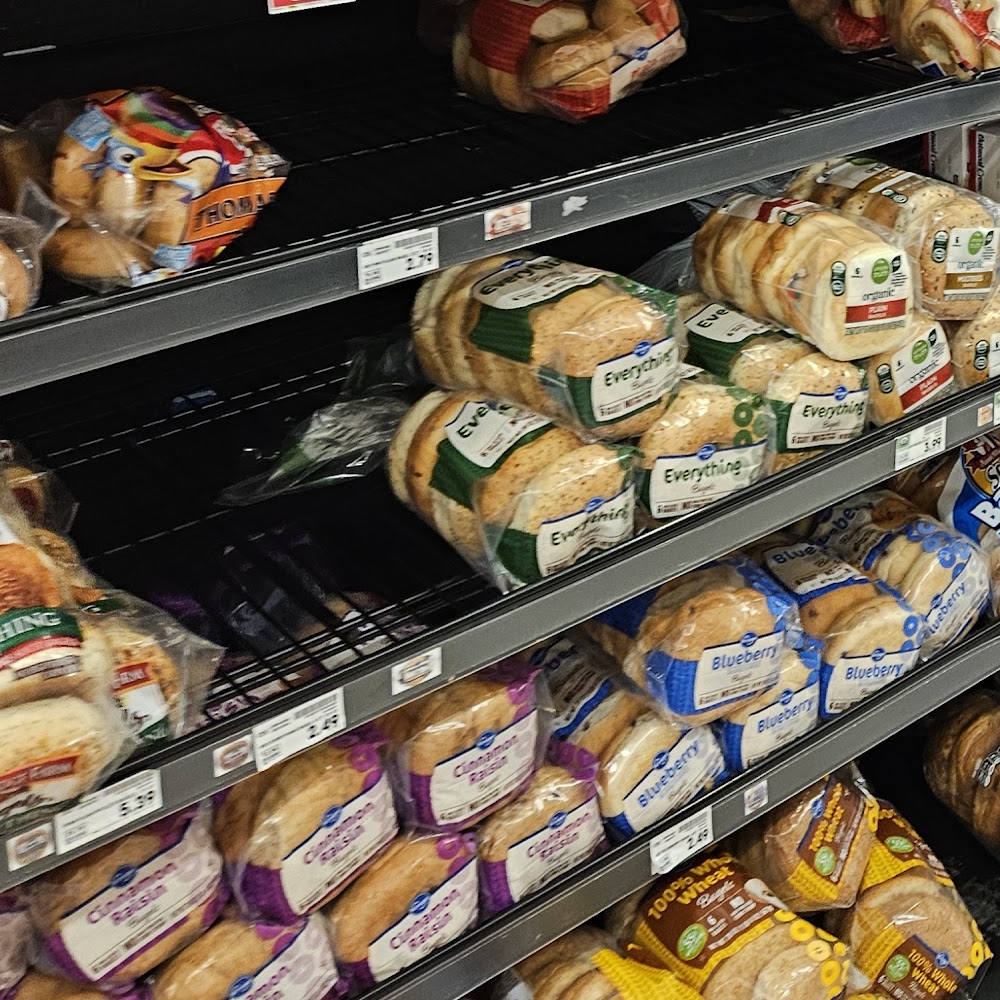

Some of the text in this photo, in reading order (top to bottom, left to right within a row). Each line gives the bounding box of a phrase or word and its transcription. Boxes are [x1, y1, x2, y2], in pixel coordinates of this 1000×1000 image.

[862, 288, 895, 301] organic
[604, 350, 674, 388] Everything
[909, 360, 940, 384] organic
[802, 399, 865, 419] Everything
[663, 455, 743, 486] Everything
[711, 642, 780, 671] Blueberry
[845, 656, 904, 681] Blueberry
[757, 696, 815, 735] Blueberry
[453, 734, 520, 779] Cinnamon
[469, 754, 508, 785] Raisin
[638, 739, 701, 809] Blueberry
[304, 801, 375, 865] Cinnamon
[539, 831, 579, 860] Raisin
[677, 866, 736, 906] Wheat
[907, 948, 958, 996] 100% Whole
[911, 967, 941, 997] Wheat
